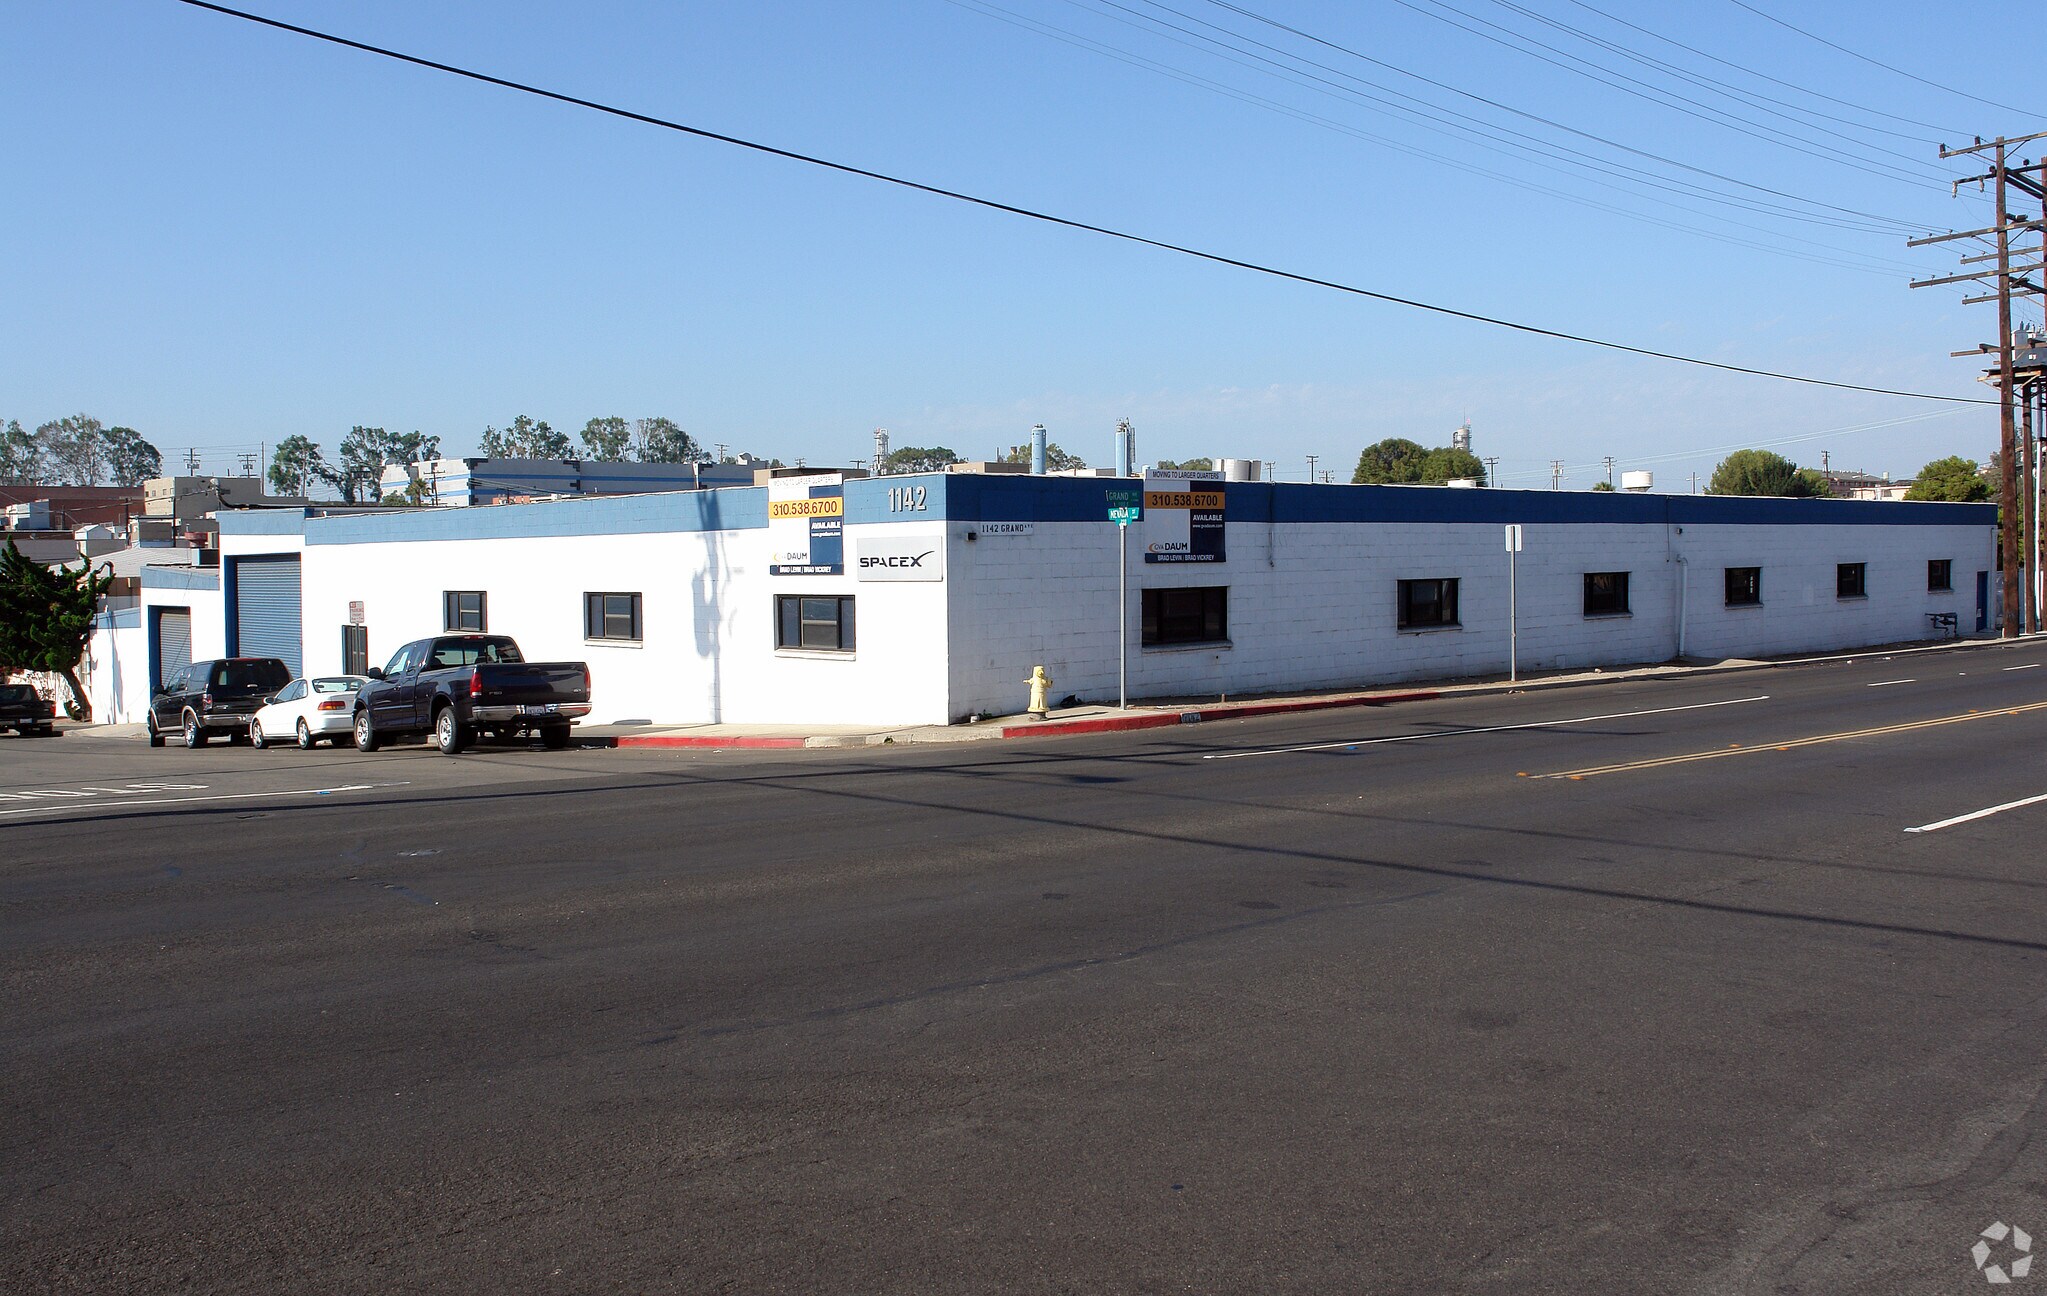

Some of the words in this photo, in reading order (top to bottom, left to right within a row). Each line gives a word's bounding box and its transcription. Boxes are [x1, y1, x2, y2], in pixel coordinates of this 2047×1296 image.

[1152, 471, 1171, 479] MOVING
[1172, 471, 1178, 479] TO
[1196, 472, 1219, 480] QUARTERS
[888, 486, 927, 512] 1142
[1151, 494, 1218, 506] 310.538.6700
[773, 501, 838, 516] 310.538.6700
[982, 524, 999, 533] 1142
[1001, 524, 1024, 533] GRAND
[1164, 542, 1188, 551] DAUM
[786, 552, 808, 561] DAUM
